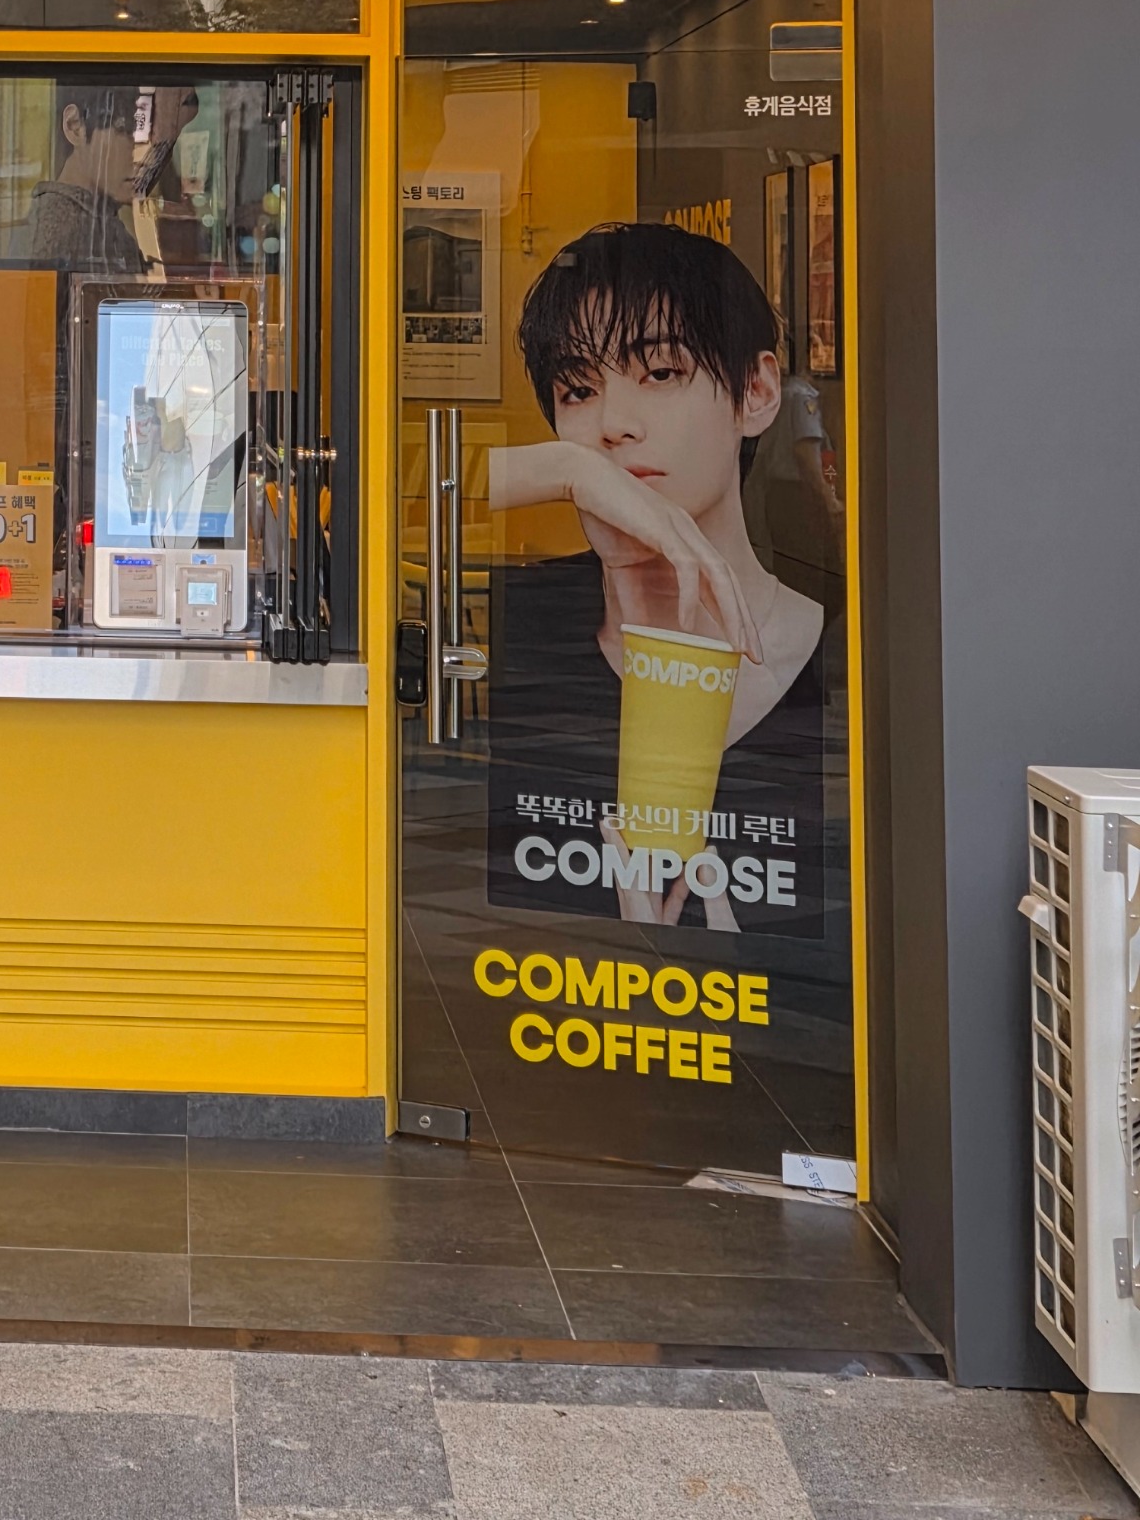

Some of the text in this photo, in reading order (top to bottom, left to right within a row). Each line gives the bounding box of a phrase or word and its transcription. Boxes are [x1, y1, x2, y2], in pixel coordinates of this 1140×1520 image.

[743, 94, 833, 117] 휴게음식점
[427, 186, 465, 201] 팩토리
[11, 495, 36, 510] 혜택
[515, 793, 797, 847] 똑똑한 당신의 커피 루틴
[514, 835, 797, 907] COMPOSE
[473, 948, 769, 1026] COMPOSE
[509, 1013, 733, 1085] COFFEE
